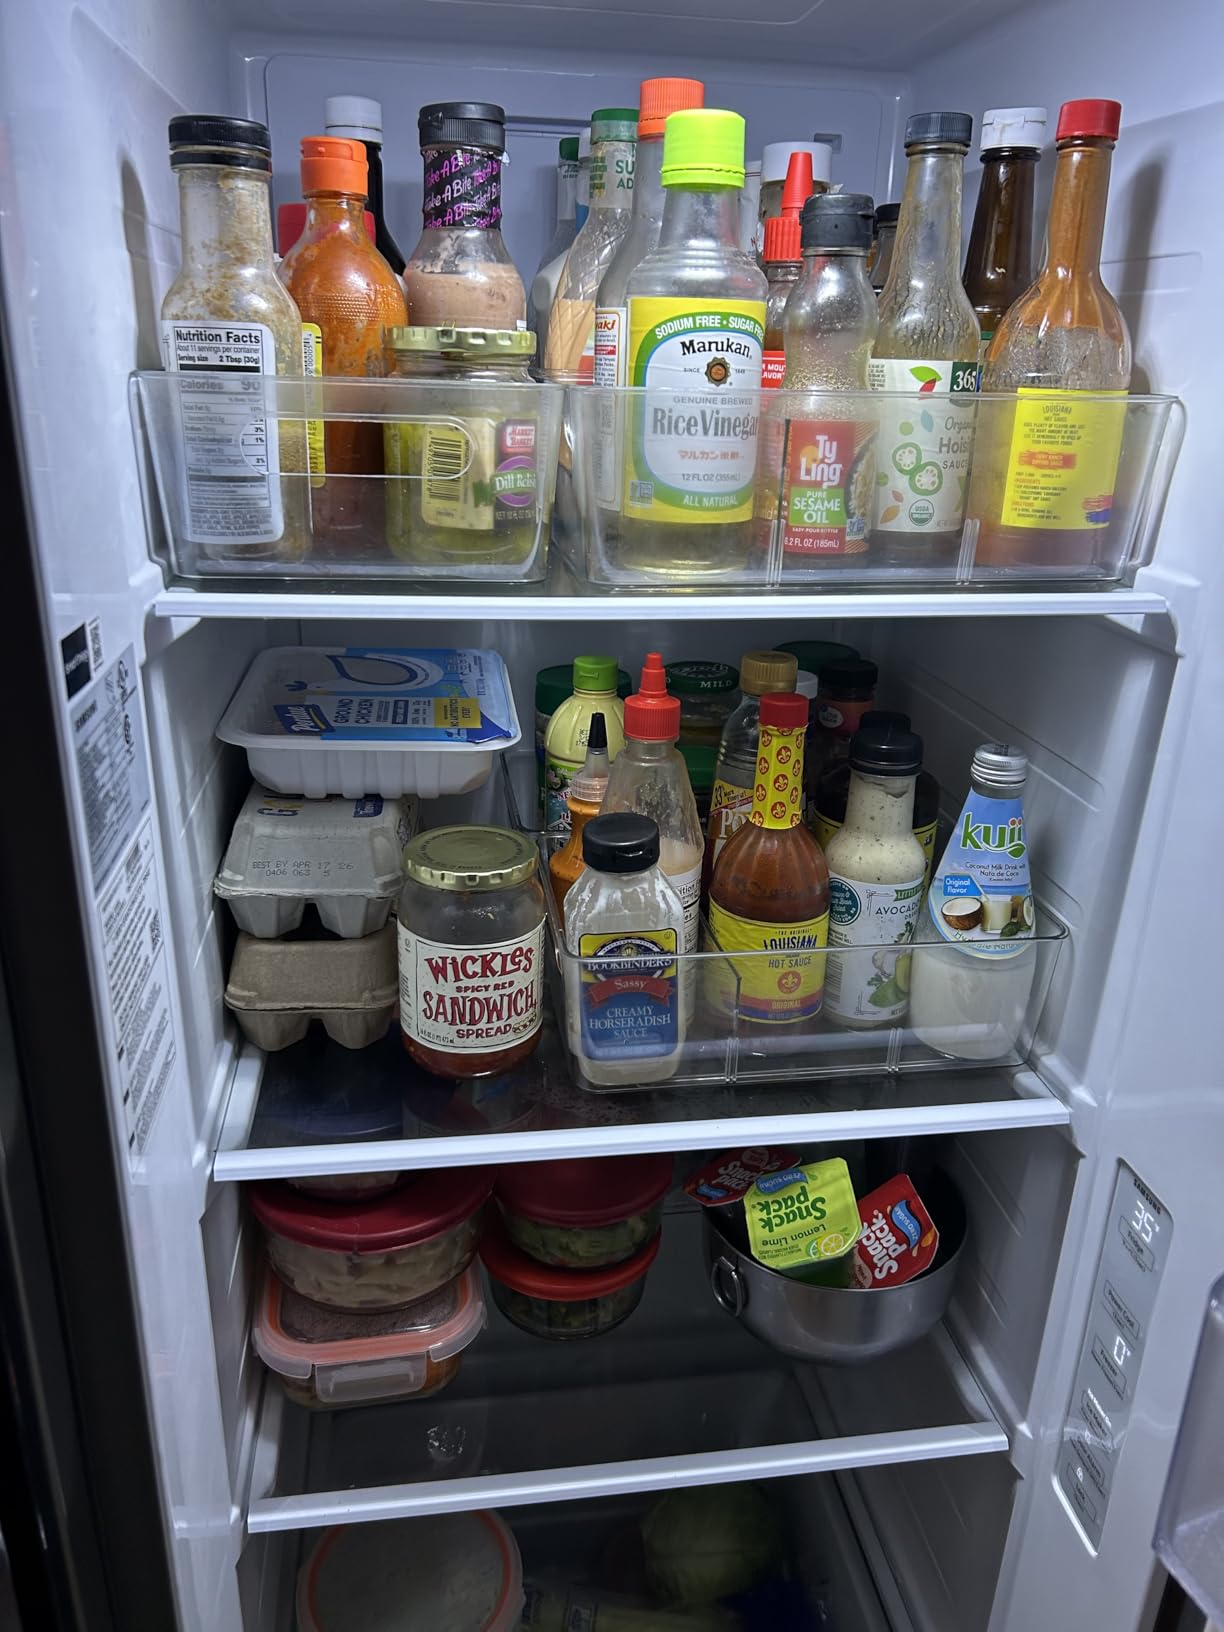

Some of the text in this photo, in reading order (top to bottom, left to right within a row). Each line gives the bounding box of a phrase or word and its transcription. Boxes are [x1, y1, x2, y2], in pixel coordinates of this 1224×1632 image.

[655, 316, 694, 340] SODIUM
[696, 315, 720, 328] FREE
[729, 316, 755, 332] SUGAR
[176, 329, 260, 344] Nutrition Facts
[197, 345, 221, 353] servings
[222, 346, 232, 354] per
[233, 346, 260, 354] container
[680, 338, 750, 359] Marukan
[178, 354, 197, 363] Serving
[225, 355, 242, 364] Tbsp
[180, 378, 261, 391] Calories 90
[953, 368, 977, 391] 365
[673, 396, 718, 405] GENUINE
[652, 407, 758, 440] Rice Vinegar
[816, 434, 837, 463] Ty
[682, 473, 692, 481] 12
[692, 473, 702, 481] FL
[703, 473, 715, 482] OZ
[800, 457, 842, 489] Ling
[495, 473, 514, 491] Dill
[683, 495, 738, 507] ALL NATURAL
[806, 490, 827, 498] PURE
[793, 498, 841, 512] SESAME
[803, 510, 829, 524] OIL
[794, 537, 802, 545] FL
[803, 538, 813, 546] OZ
[814, 538, 840, 549] (185mL)
[700, 679, 733, 689] MILD
[334, 699, 353, 724] GROUND
[355, 699, 374, 724] CHICKEN
[253, 861, 270, 869] BEST
[292, 861, 310, 869] APR
[965, 861, 990, 870] Coconut
[945, 878, 971, 886] Original
[763, 934, 818, 950] LOUISIANA
[768, 956, 812, 969] HOT SAUCE
[456, 980, 515, 993] SPICY RED
[614, 978, 647, 990] Sassy
[423, 979, 537, 1026] SANDWICH
[606, 1005, 653, 1018] CREAMY
[590, 1013, 671, 1029] HORSERADISH
[456, 1023, 512, 1039] SPREAD
[614, 1028, 648, 1038] SAUCE
[756, 1185, 809, 1216] pack
[1133, 1178, 1161, 1215] SAMSUNG
[758, 1197, 826, 1233] Snack
[761, 1224, 826, 1248] Lemon Lime
[873, 1213, 907, 1258] pack
[858, 1222, 899, 1280] Snack
